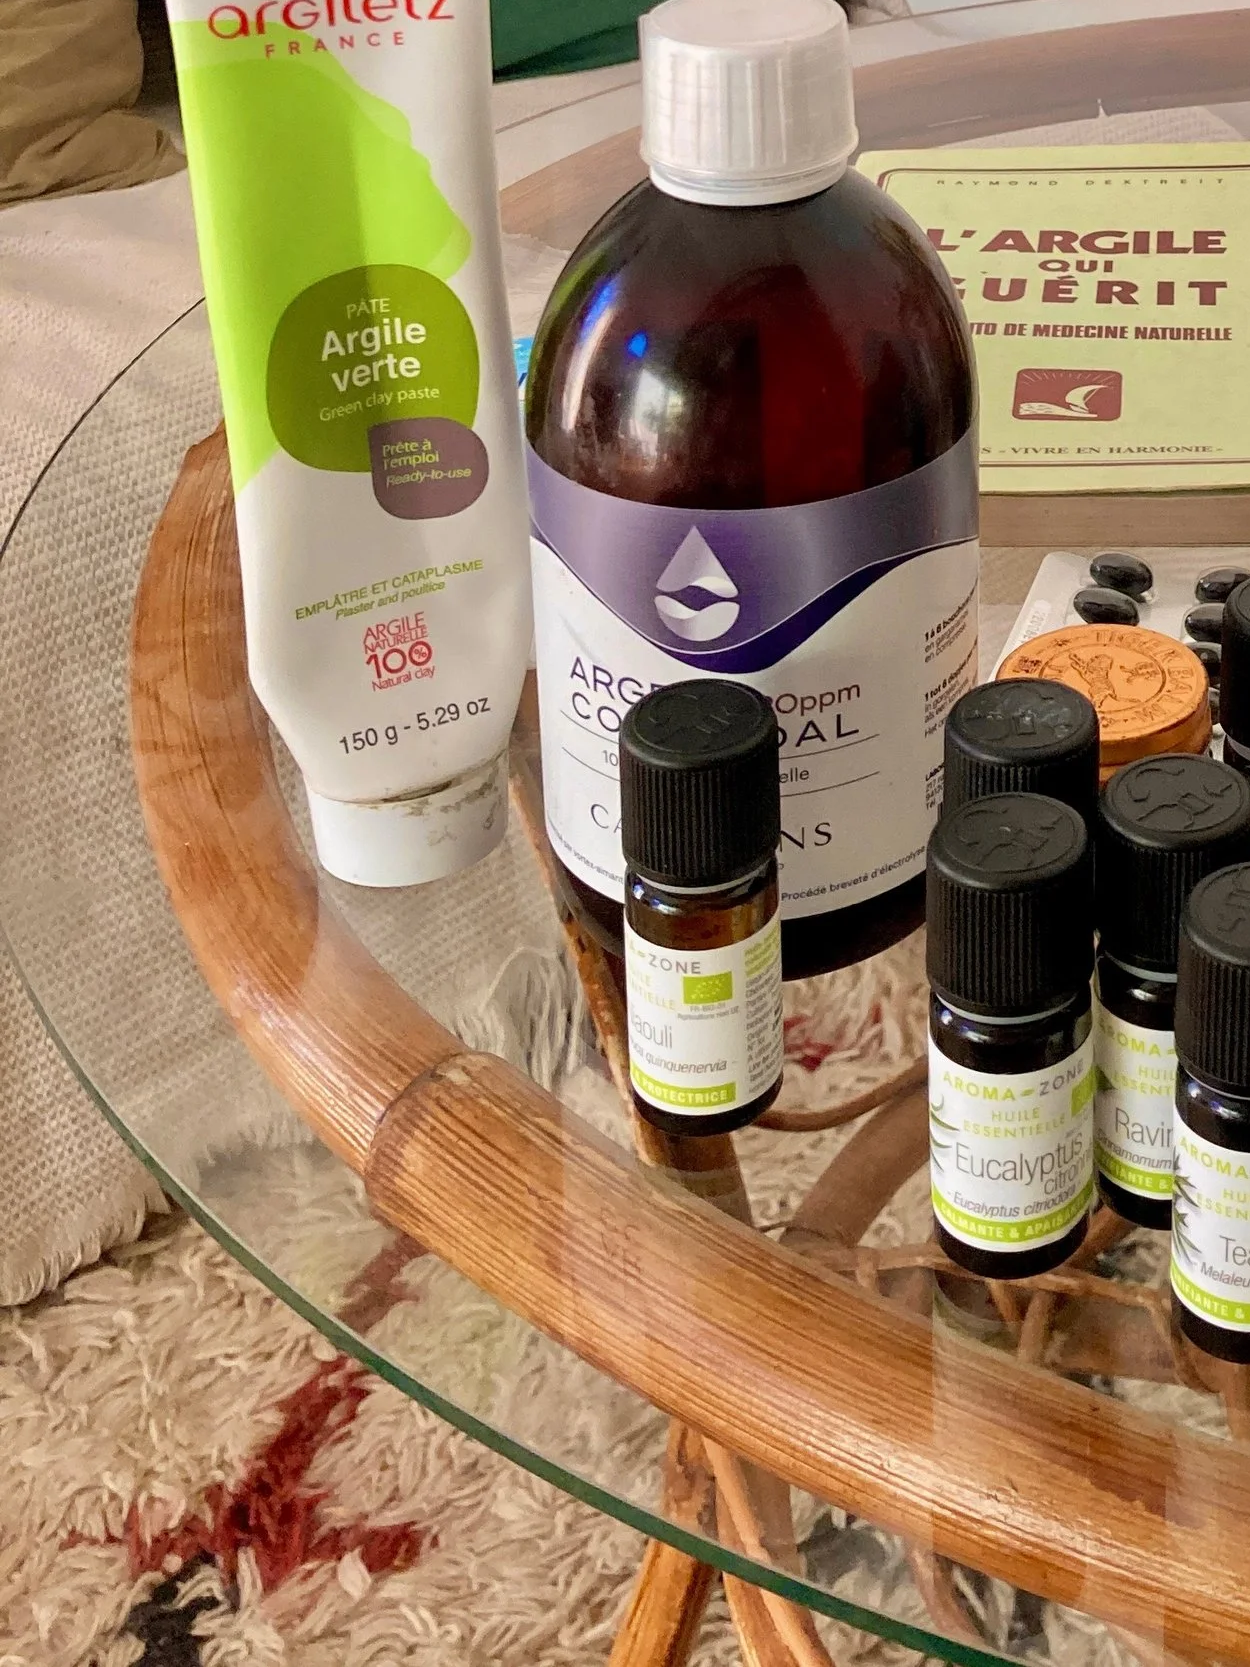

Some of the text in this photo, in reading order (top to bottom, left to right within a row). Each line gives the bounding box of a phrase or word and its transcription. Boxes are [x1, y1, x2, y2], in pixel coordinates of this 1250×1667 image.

[265, 31, 405, 59] FRANCE
[936, 177, 1225, 187] RAYMOND DEXTREIT
[926, 228, 1227, 255] L'ARGILE
[1038, 258, 1114, 274] QUI
[955, 274, 1228, 306] UÉRIT
[320, 317, 427, 362] Argile
[1003, 323, 1028, 338] DE
[1032, 323, 1128, 340] MEDECINE
[1134, 326, 1232, 341] NATURELLE
[331, 352, 421, 393] verte
[319, 386, 440, 422] Green clay paste
[422, 437, 432, 451] à
[1010, 446, 1070, 455] VIVRE
[1076, 446, 1102, 455] EN
[1108, 445, 1213, 455] HARMONIE
[295, 559, 484, 620] EMPLÂTRE ET CATAPLASME
[335, 580, 446, 620] Plaster and poultice
[363, 611, 425, 645] ARGILE
[364, 626, 429, 654] NATURELLE
[372, 665, 436, 692] Natural clay
[339, 726, 379, 755] 150
[384, 725, 399, 746] g
[416, 702, 460, 732] 5.29
[466, 696, 491, 716] oz
[648, 953, 702, 975] ZONE
[943, 1059, 1084, 1102] AROMA ZONE
[962, 1114, 1066, 1139] ESSENTIELLE
[991, 1106, 1041, 1123] HUILE
[955, 1131, 1084, 1186] Eucalyptus
[1179, 1138, 1249, 1180] AROMA
[953, 1190, 1021, 1219] Eucalyptus
